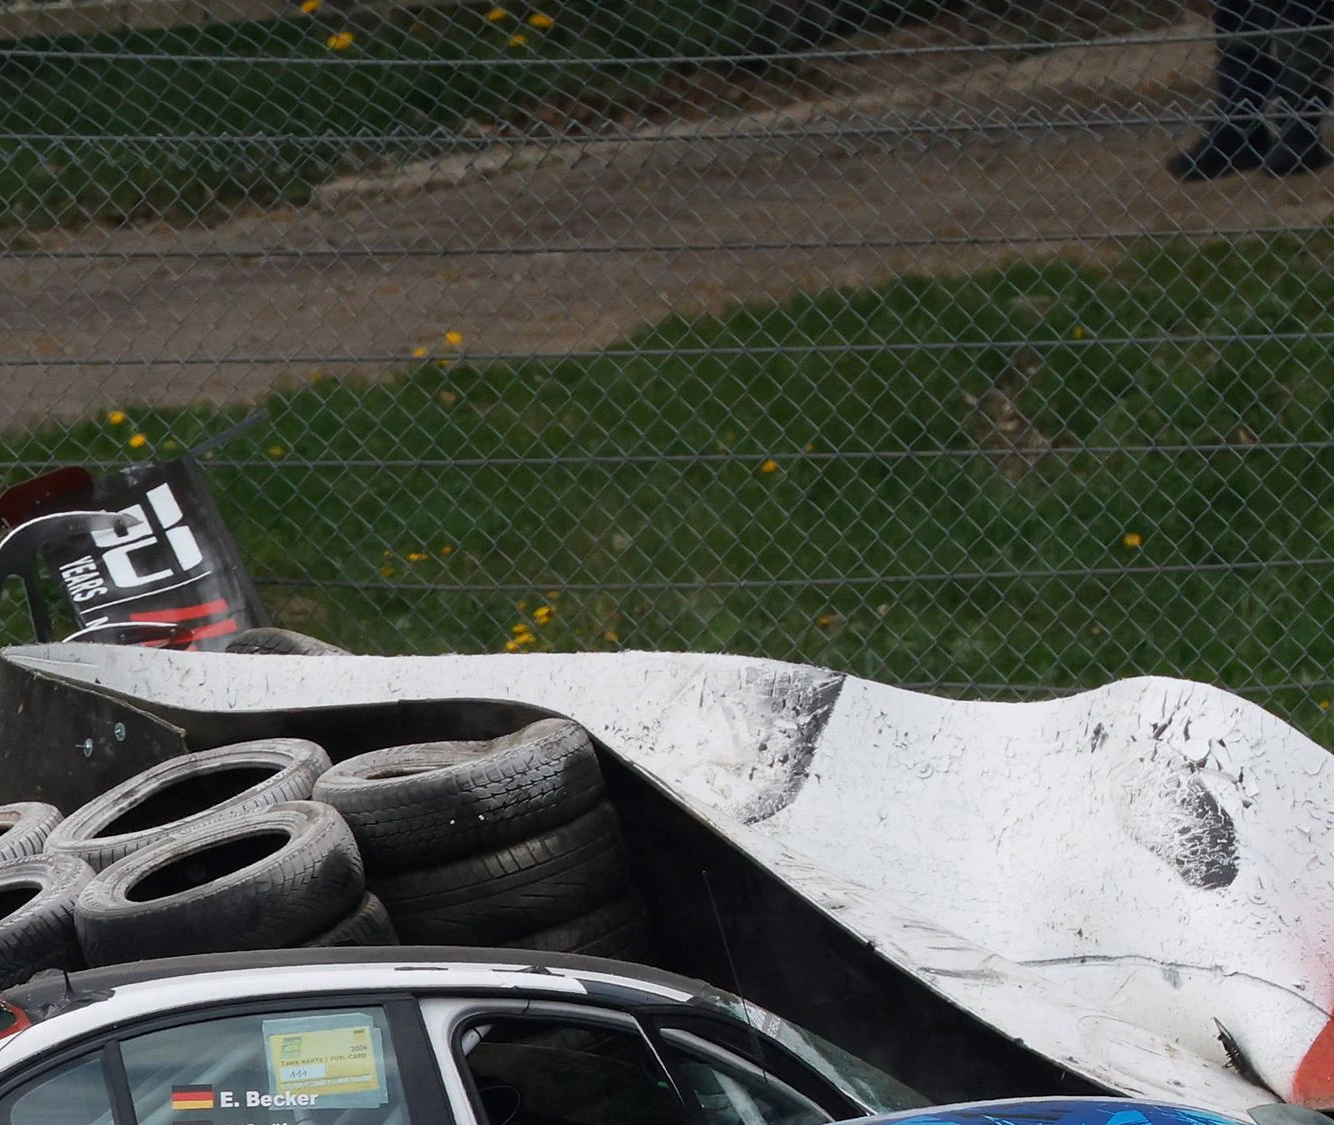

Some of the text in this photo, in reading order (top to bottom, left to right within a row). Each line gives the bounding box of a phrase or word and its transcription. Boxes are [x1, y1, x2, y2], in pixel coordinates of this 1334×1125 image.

[58, 554, 109, 603] YEARS
[219, 1090, 319, 1108] E. Becker
